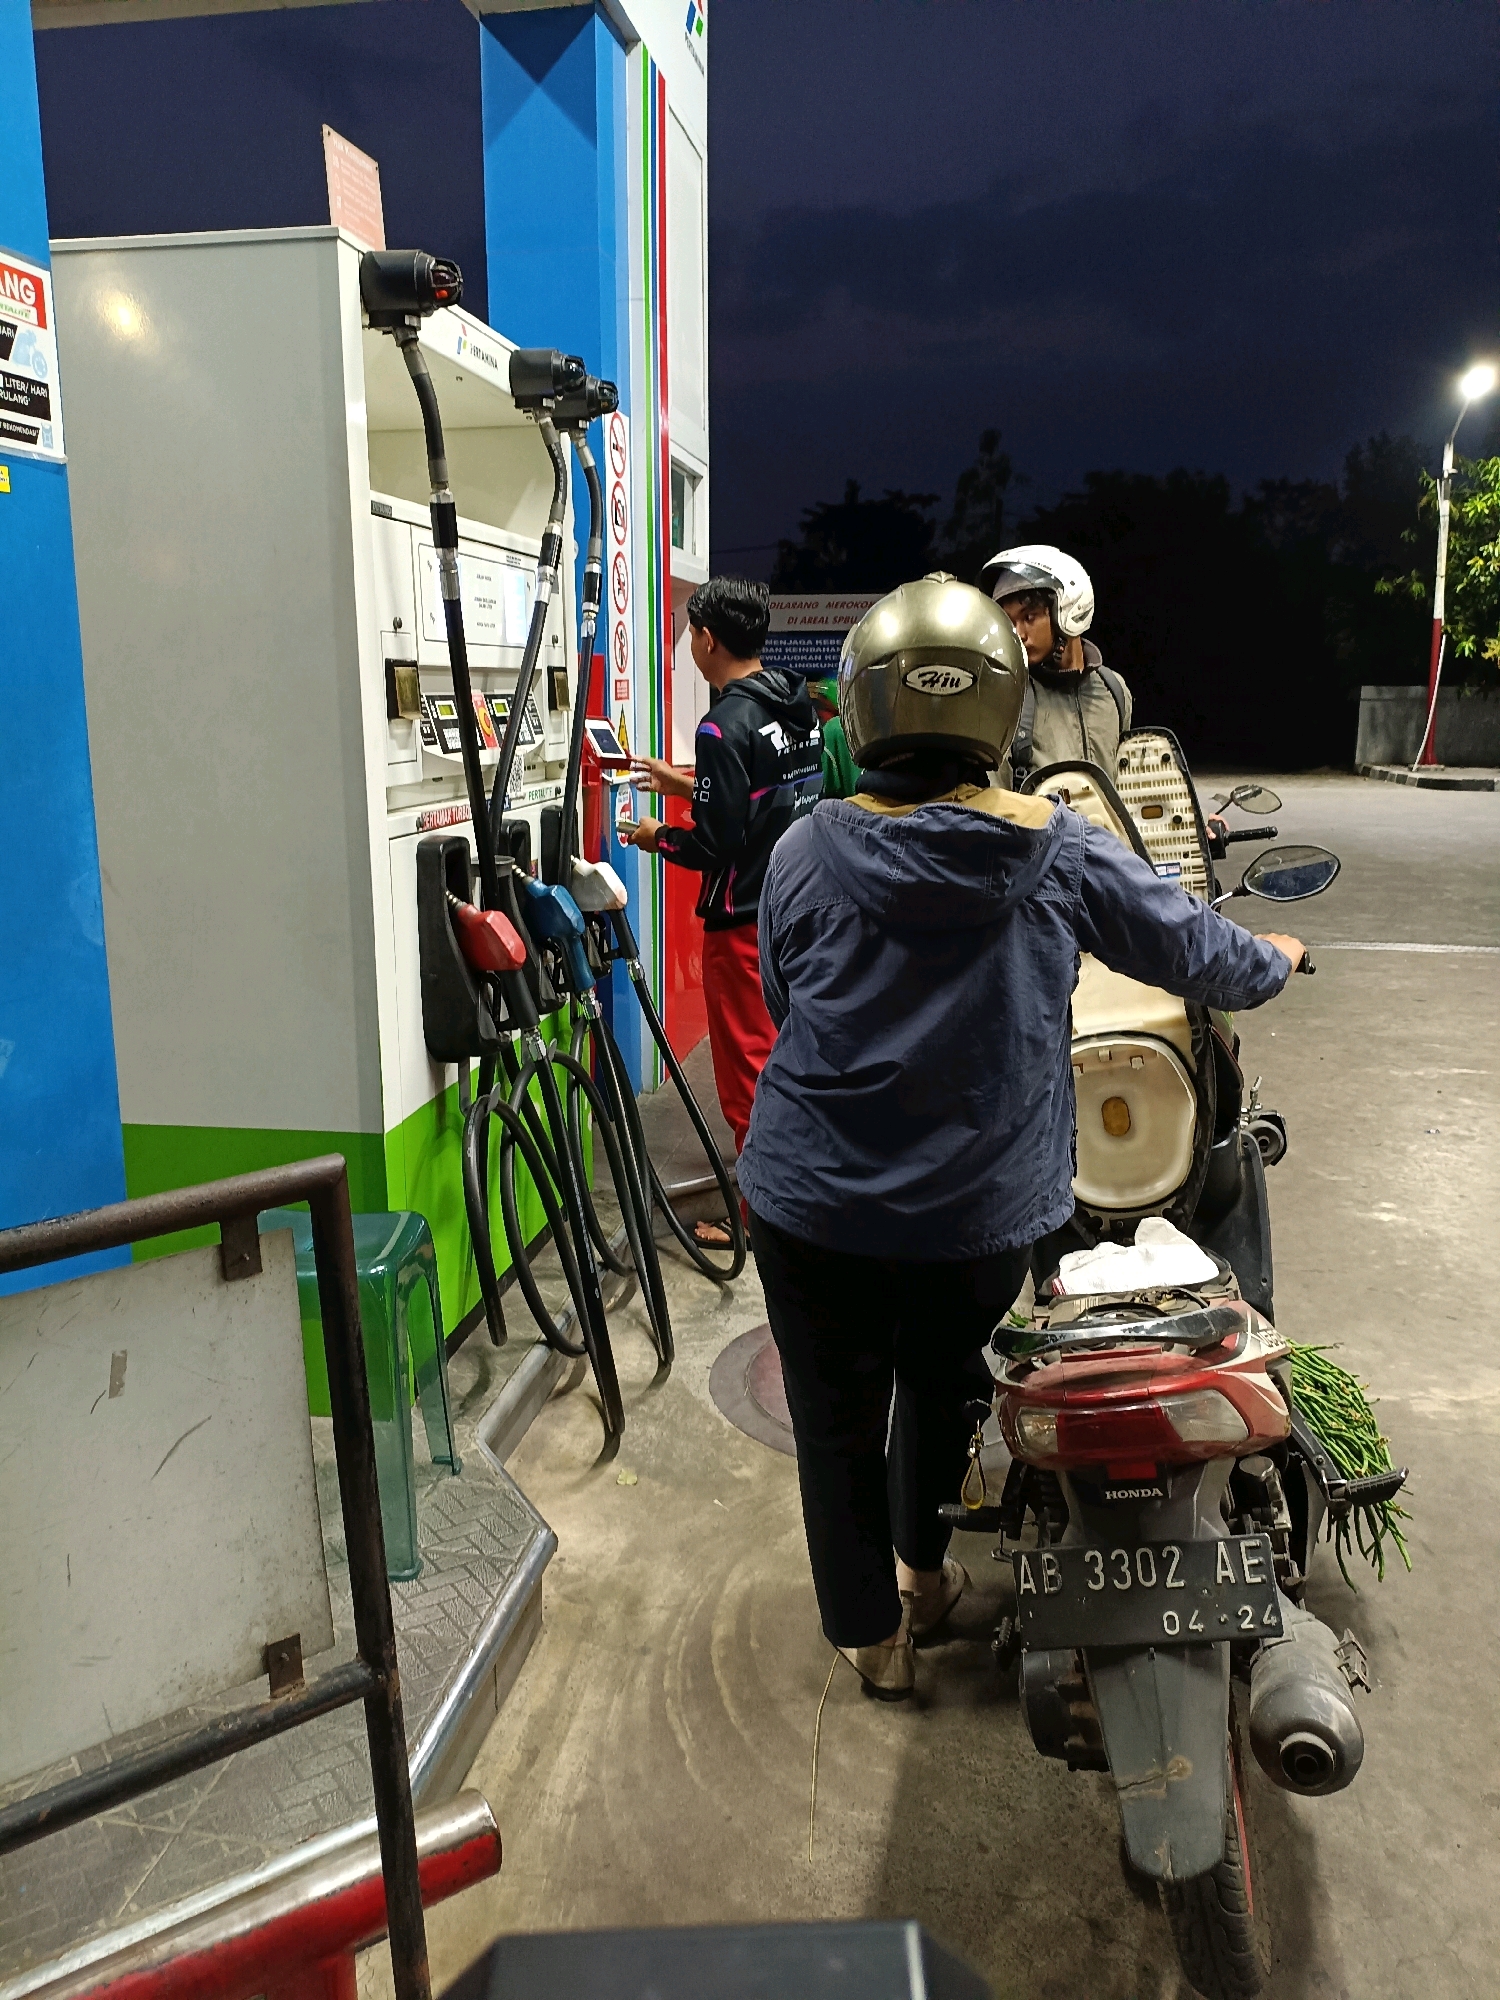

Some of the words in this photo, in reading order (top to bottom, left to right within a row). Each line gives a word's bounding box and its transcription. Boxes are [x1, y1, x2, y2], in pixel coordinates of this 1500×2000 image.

[769, 601, 820, 610] DILARANG
[786, 616, 799, 625] DI
[799, 616, 829, 625] AREAL
[832, 615, 858, 625] SPBU
[1104, 1486, 1164, 1500] HONDA
[1019, 1551, 1063, 1596] AB
[1084, 1545, 1186, 1591] 3302
[1215, 1538, 1267, 1585] AE
